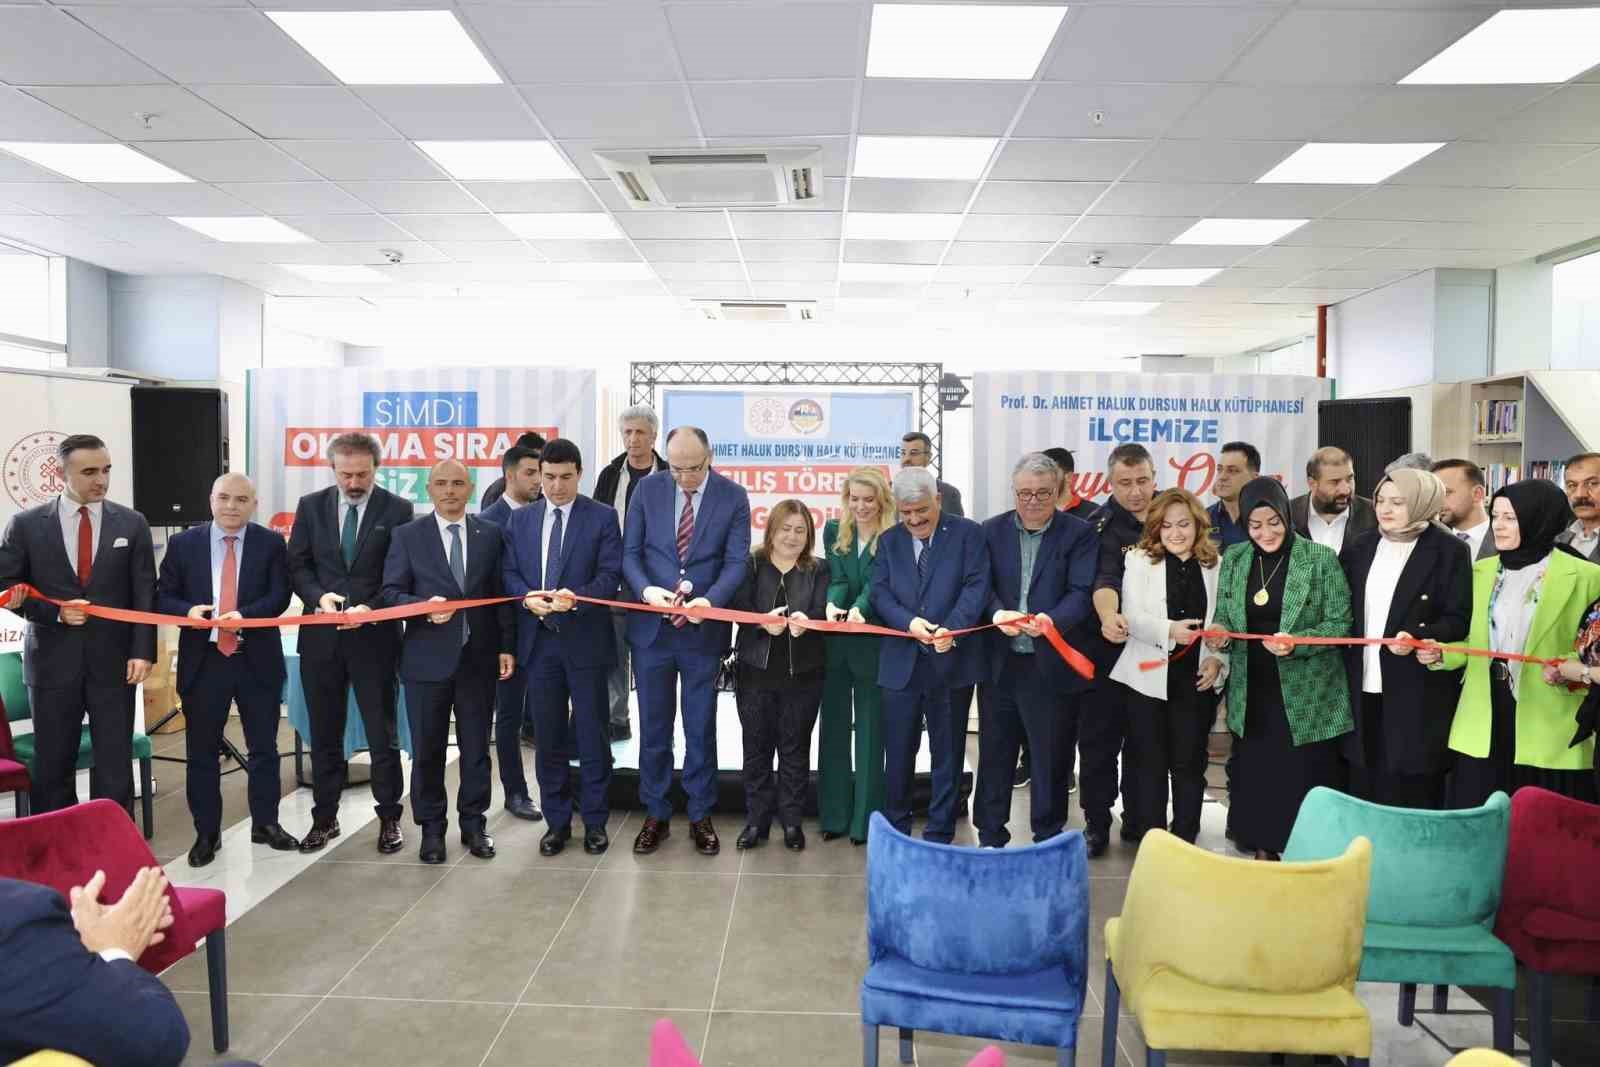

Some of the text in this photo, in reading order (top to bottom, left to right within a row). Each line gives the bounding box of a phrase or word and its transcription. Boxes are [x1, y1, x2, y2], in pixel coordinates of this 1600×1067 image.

[1000, 395, 1305, 414] Prof. Dr. AHMET HALUK DURSUN HALK KÜTÜPHANESİ
[292, 432, 547, 460] OKMA SIRA
[711, 443, 738, 457] HMET
[741, 443, 772, 457] HALUK
